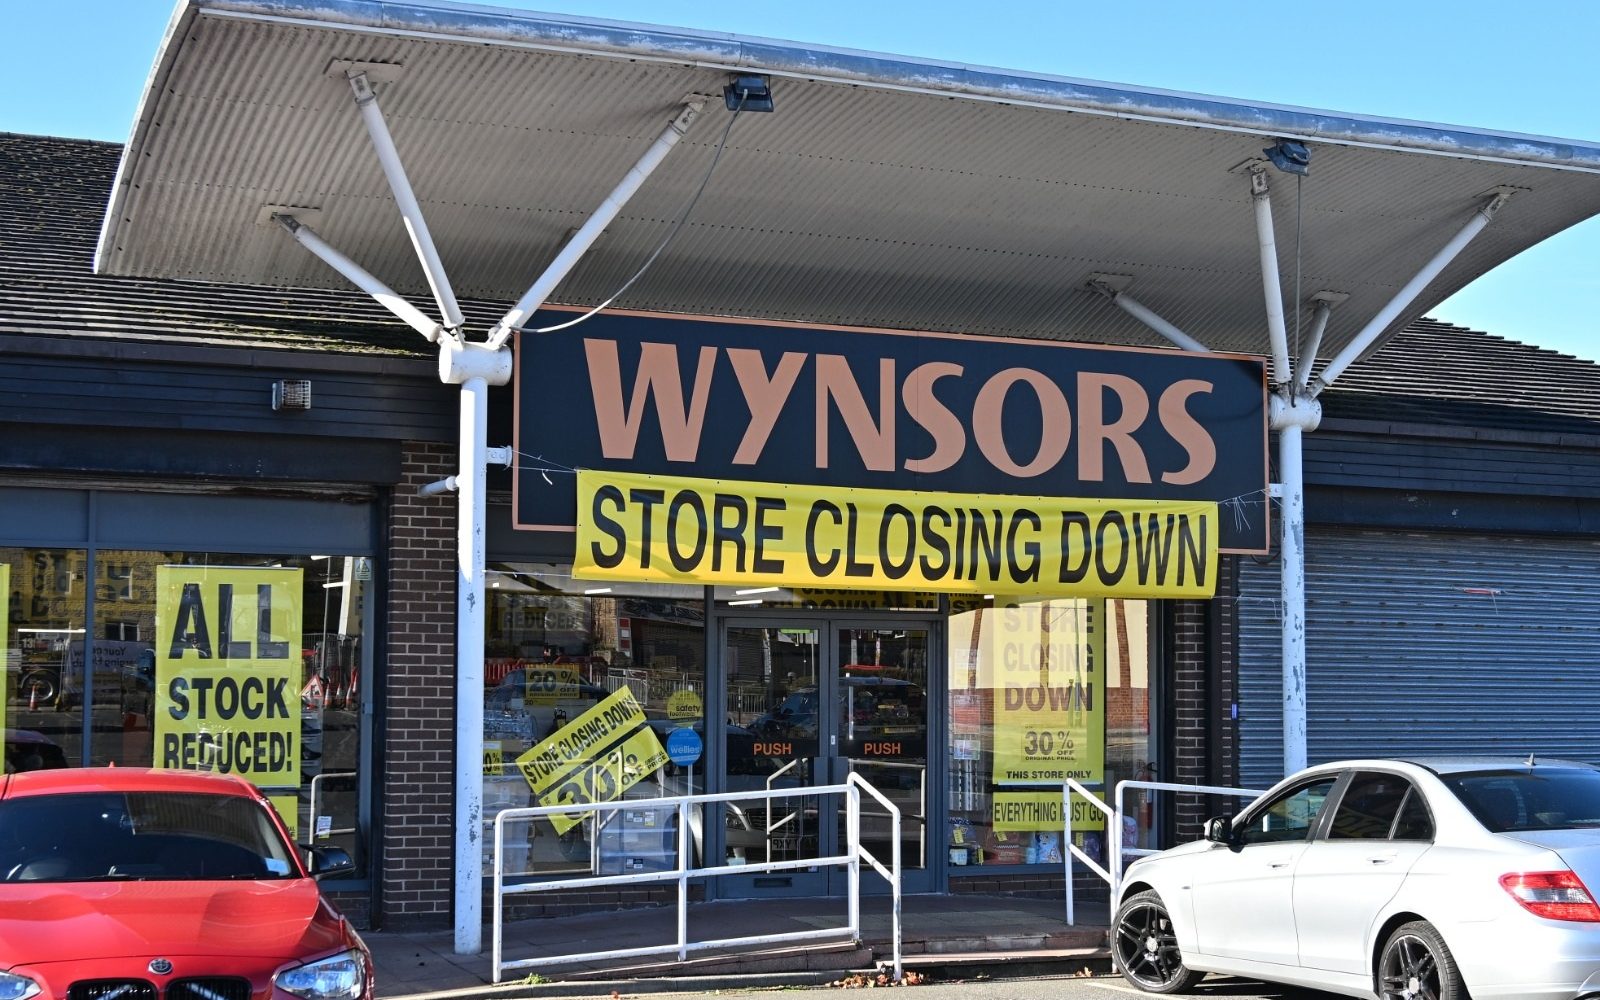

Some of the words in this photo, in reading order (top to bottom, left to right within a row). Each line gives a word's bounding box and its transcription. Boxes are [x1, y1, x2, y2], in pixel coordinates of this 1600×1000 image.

[584, 338, 1217, 485] WYNSORS
[591, 484, 787, 574] STORE
[805, 499, 1042, 584] CLOSING
[1058, 509, 1207, 587] DOWN
[168, 583, 290, 660] ALL
[1004, 603, 1094, 633] STORE
[1004, 642, 1094, 672] CLOSING
[168, 676, 290, 721] STOCK
[675, 704, 700, 713] safety
[1005, 681, 1093, 712] DOWN
[163, 731, 293, 774] REDUCED!
[523, 746, 565, 785] STORE
[558, 716, 609, 760] CLOSING
[647, 754, 668, 769] PRICE
[670, 745, 701, 754] wellies
[753, 742, 792, 756] PUSH
[864, 742, 901, 755] PUSH
[1006, 770, 1029, 779] THIS
[1032, 770, 1064, 779] STORE
[1066, 769, 1092, 779] ONLY
[994, 802, 1057, 821] EVERYTHING
